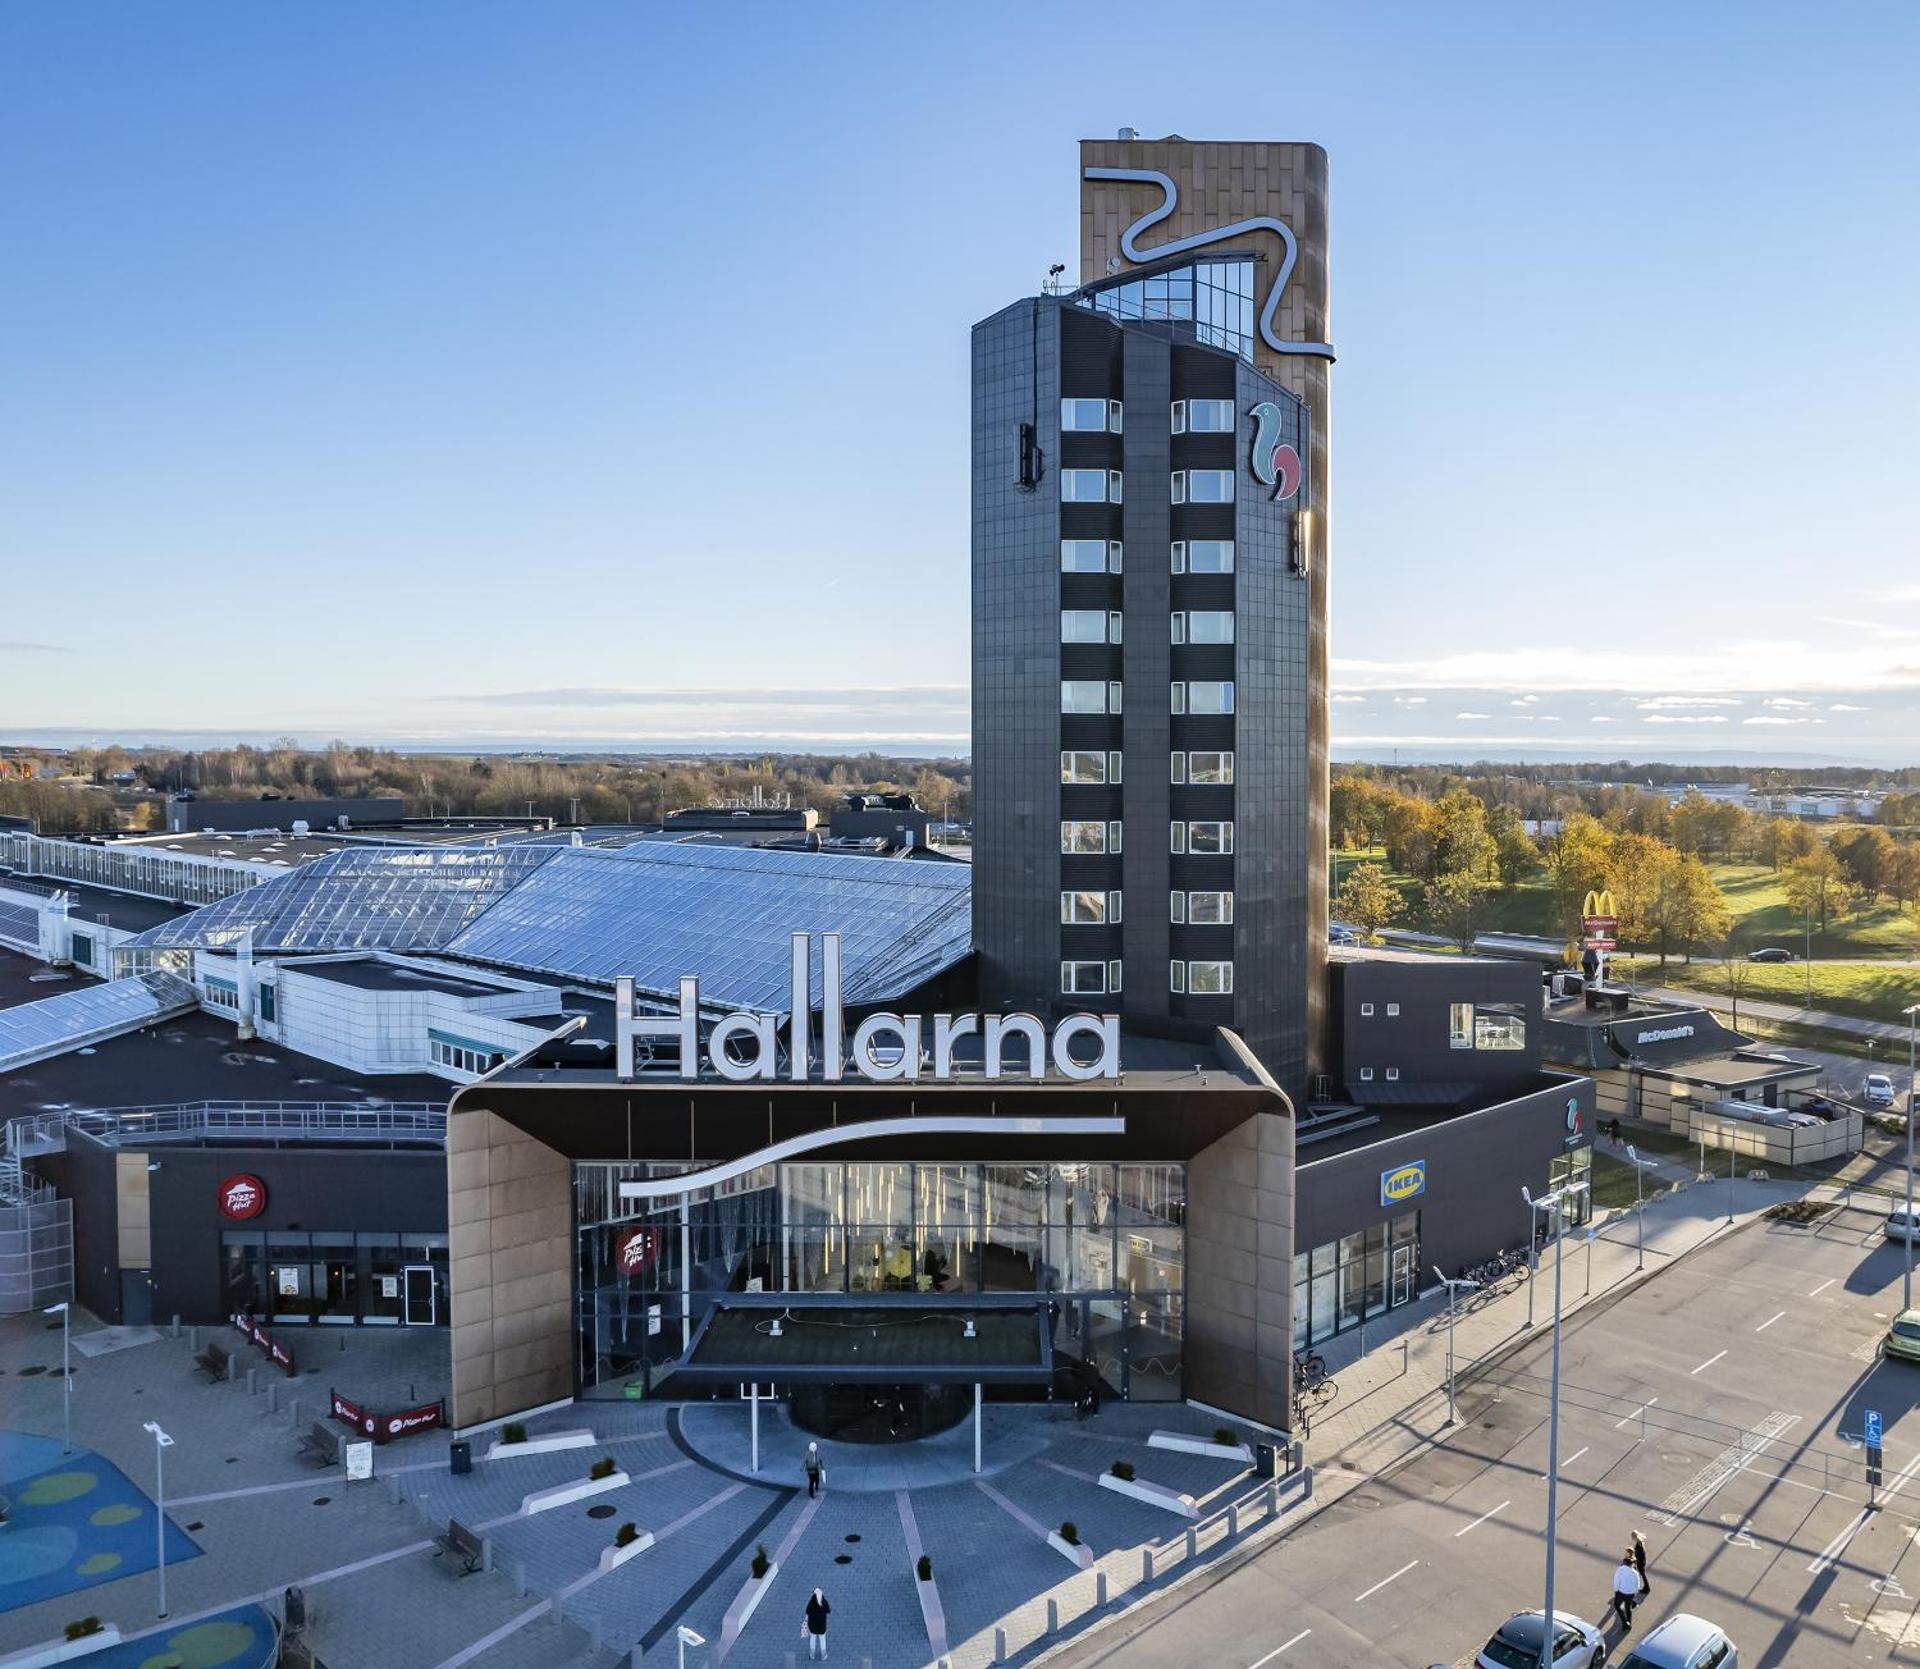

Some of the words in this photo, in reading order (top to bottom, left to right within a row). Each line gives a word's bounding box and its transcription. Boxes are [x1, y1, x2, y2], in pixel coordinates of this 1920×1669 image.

[615, 932, 1120, 1081] Hallarna
[1388, 1173, 1422, 1194] IKEA
[1869, 1413, 1878, 1424] P
